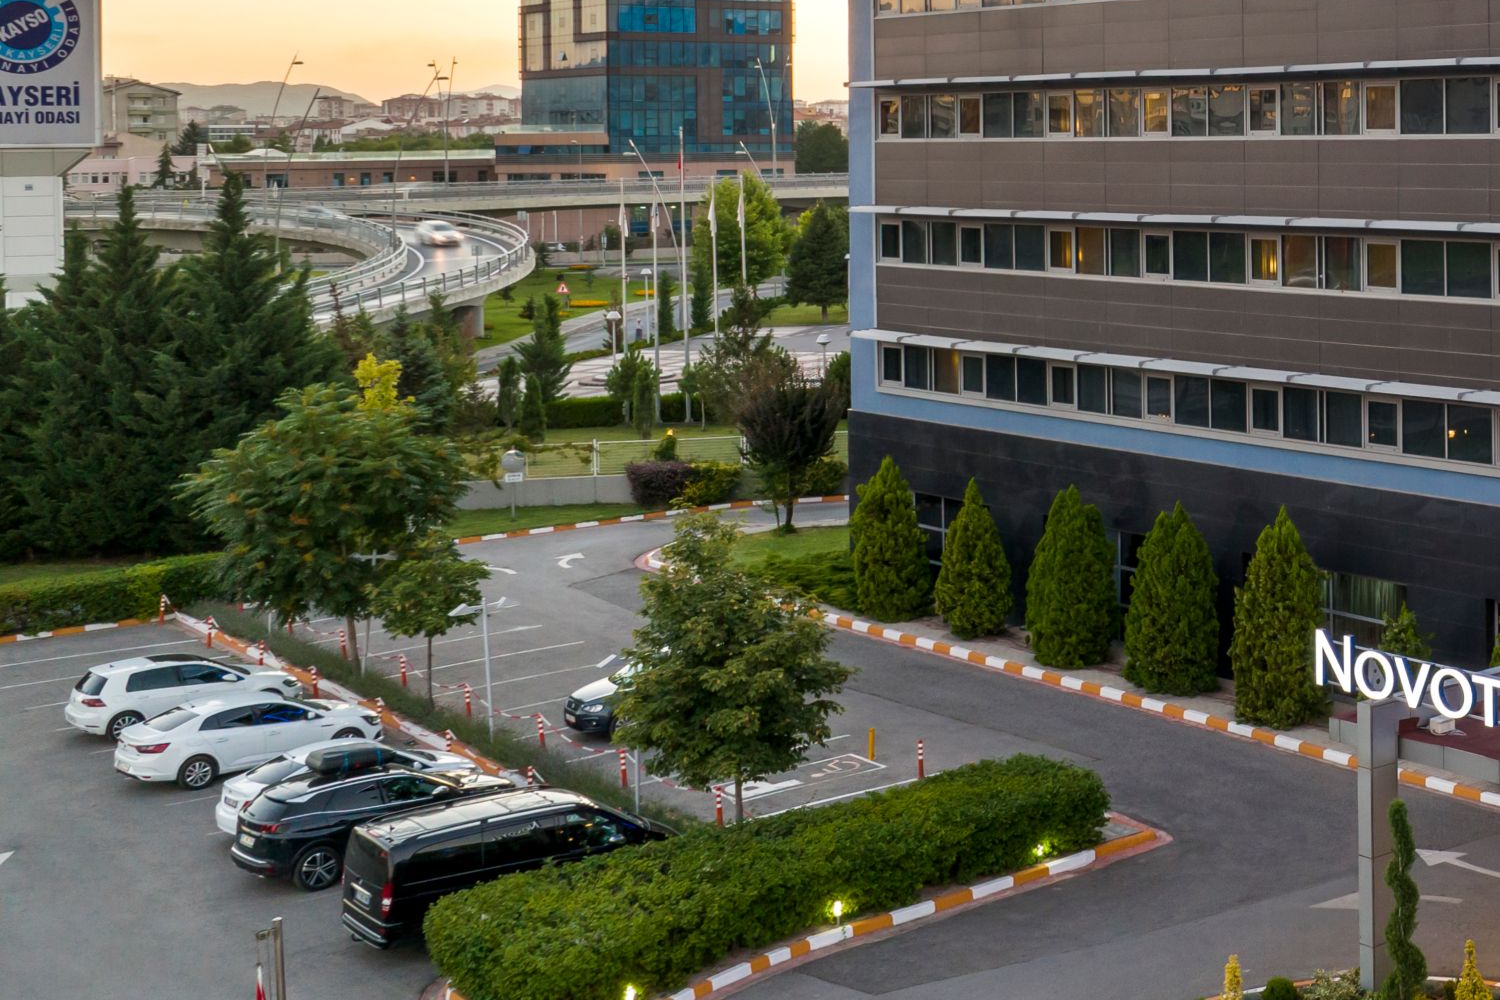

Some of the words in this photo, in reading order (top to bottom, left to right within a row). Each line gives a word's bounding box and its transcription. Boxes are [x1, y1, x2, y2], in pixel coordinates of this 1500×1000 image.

[0, 8, 49, 42] KAYSO
[0, 108, 30, 125] AYİ
[35, 111, 80, 124] ODASI
